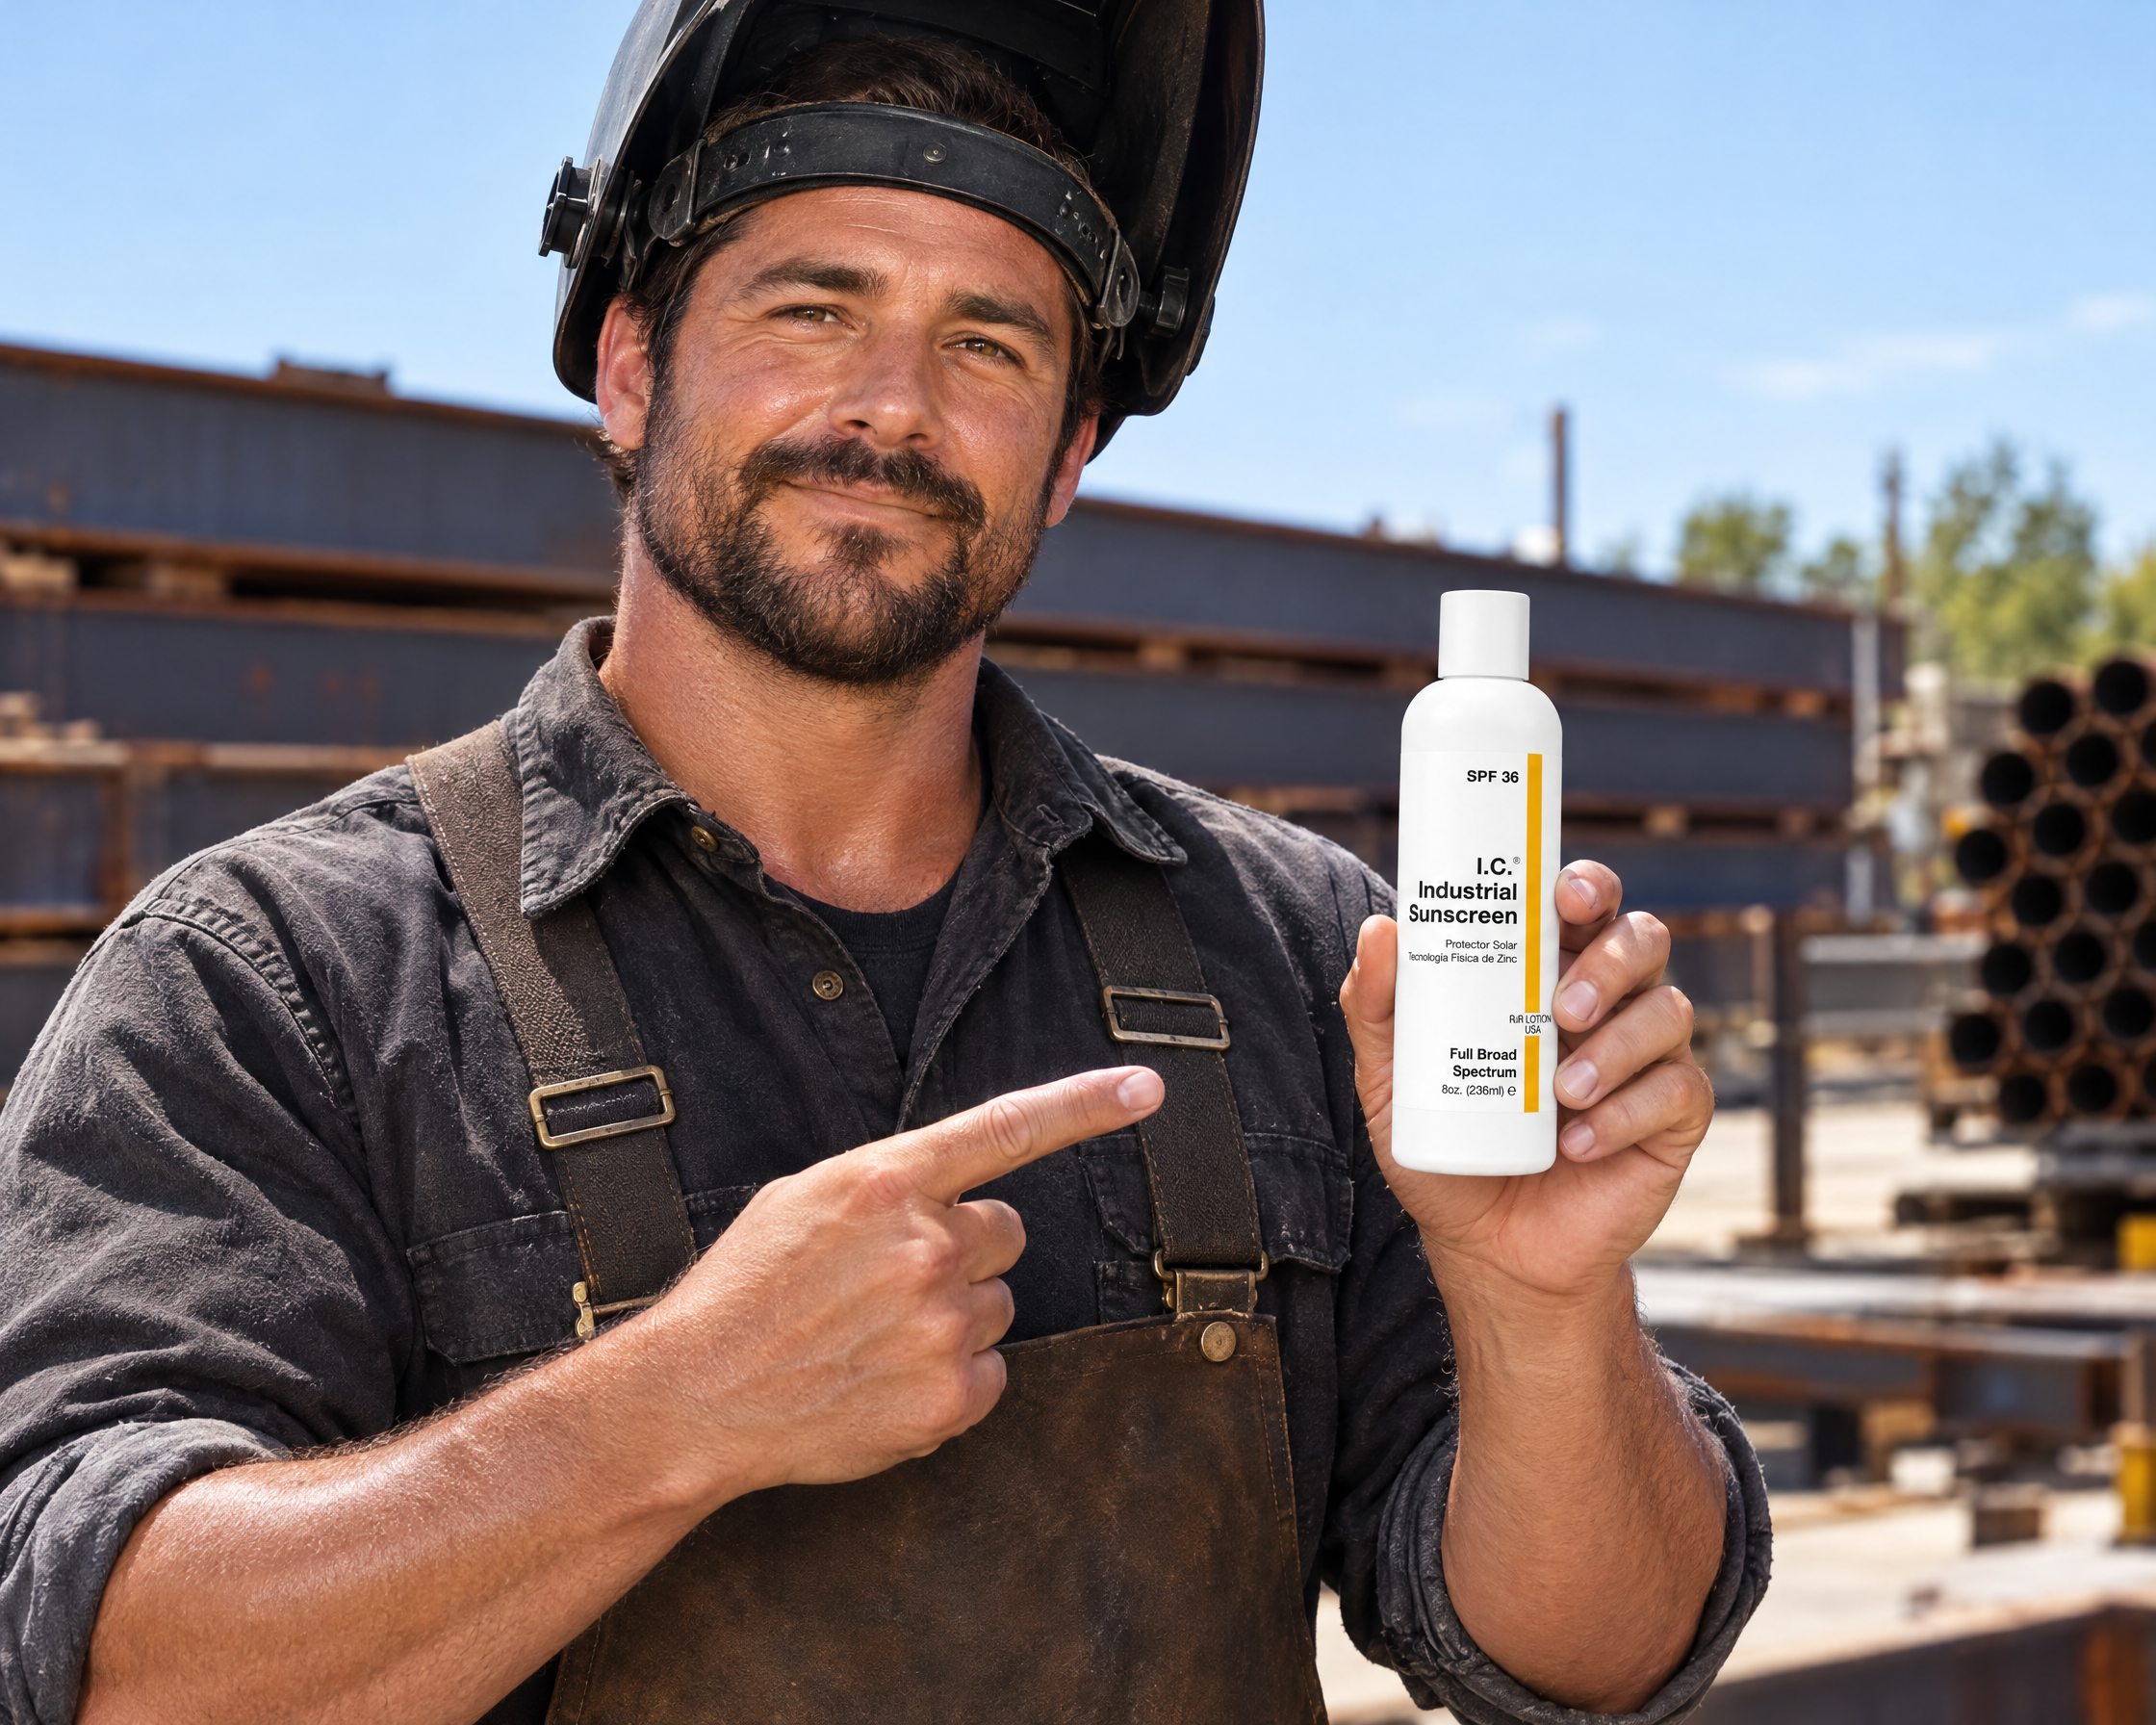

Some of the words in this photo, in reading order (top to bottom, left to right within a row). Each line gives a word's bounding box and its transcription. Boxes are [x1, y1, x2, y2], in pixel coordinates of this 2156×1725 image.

[1467, 770, 1497, 783] SPF
[1502, 771, 1519, 783] 36
[1419, 881, 1517, 900] Industrial
[1409, 904, 1517, 924] Sunscreen
[1446, 940, 1490, 949] Protector
[1493, 940, 1517, 950] Solar
[1481, 954, 1494, 964] de
[1497, 954, 1517, 964] Zinc
[1526, 1015, 1552, 1024] LOTION
[1525, 1025, 1541, 1034] USA
[1450, 1047, 1473, 1060] Full
[1477, 1048, 1517, 1061] Broad
[1452, 1066, 1517, 1079] Spectrum
[1441, 1085, 1462, 1094] 8oz.
[1466, 1085, 1504, 1097] (236ml)
